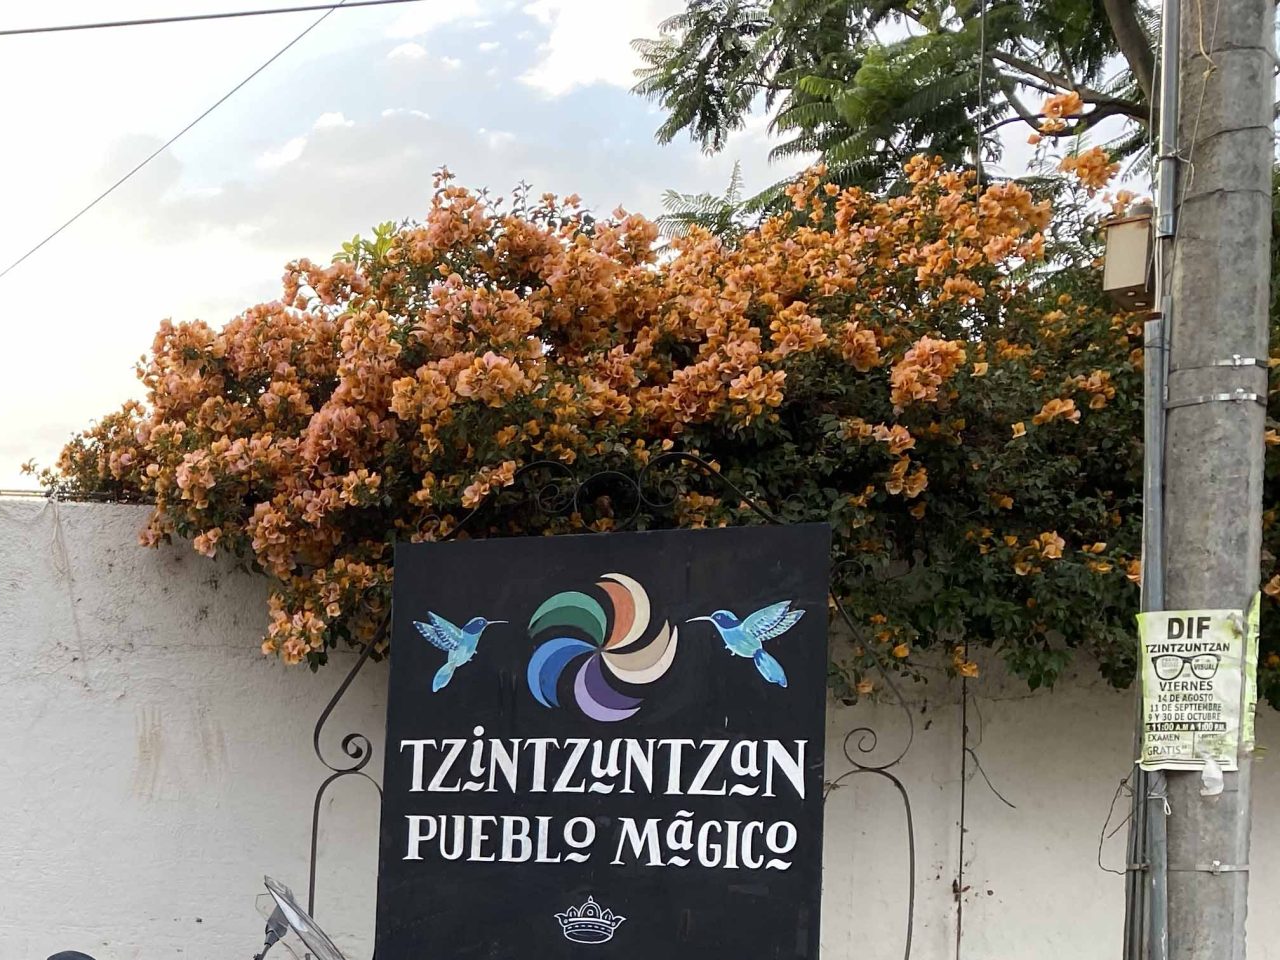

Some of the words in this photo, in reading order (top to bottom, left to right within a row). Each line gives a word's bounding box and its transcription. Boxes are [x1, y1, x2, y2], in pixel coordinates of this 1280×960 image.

[1168, 617, 1211, 639] DIF
[1146, 643, 1230, 653] TZINTZUNTZAN
[1160, 681, 1213, 691] VIERNES
[1158, 694, 1168, 702] 14
[1169, 694, 1180, 702] DE
[1182, 693, 1213, 702] AGOSTO
[1150, 704, 1159, 712] 11
[1161, 703, 1172, 712] DE
[1174, 703, 1222, 712] SEPTIEMBRE
[1154, 713, 1160, 721] Y
[1162, 713, 1172, 721] 30
[1174, 713, 1185, 721] DE
[1186, 712, 1222, 721] OCTUBRE
[1197, 723, 1213, 731] 1:00
[1148, 734, 1180, 742] EXAMEN
[1148, 746, 1181, 756] GRATIS
[402, 815, 596, 864] PUEBLO
